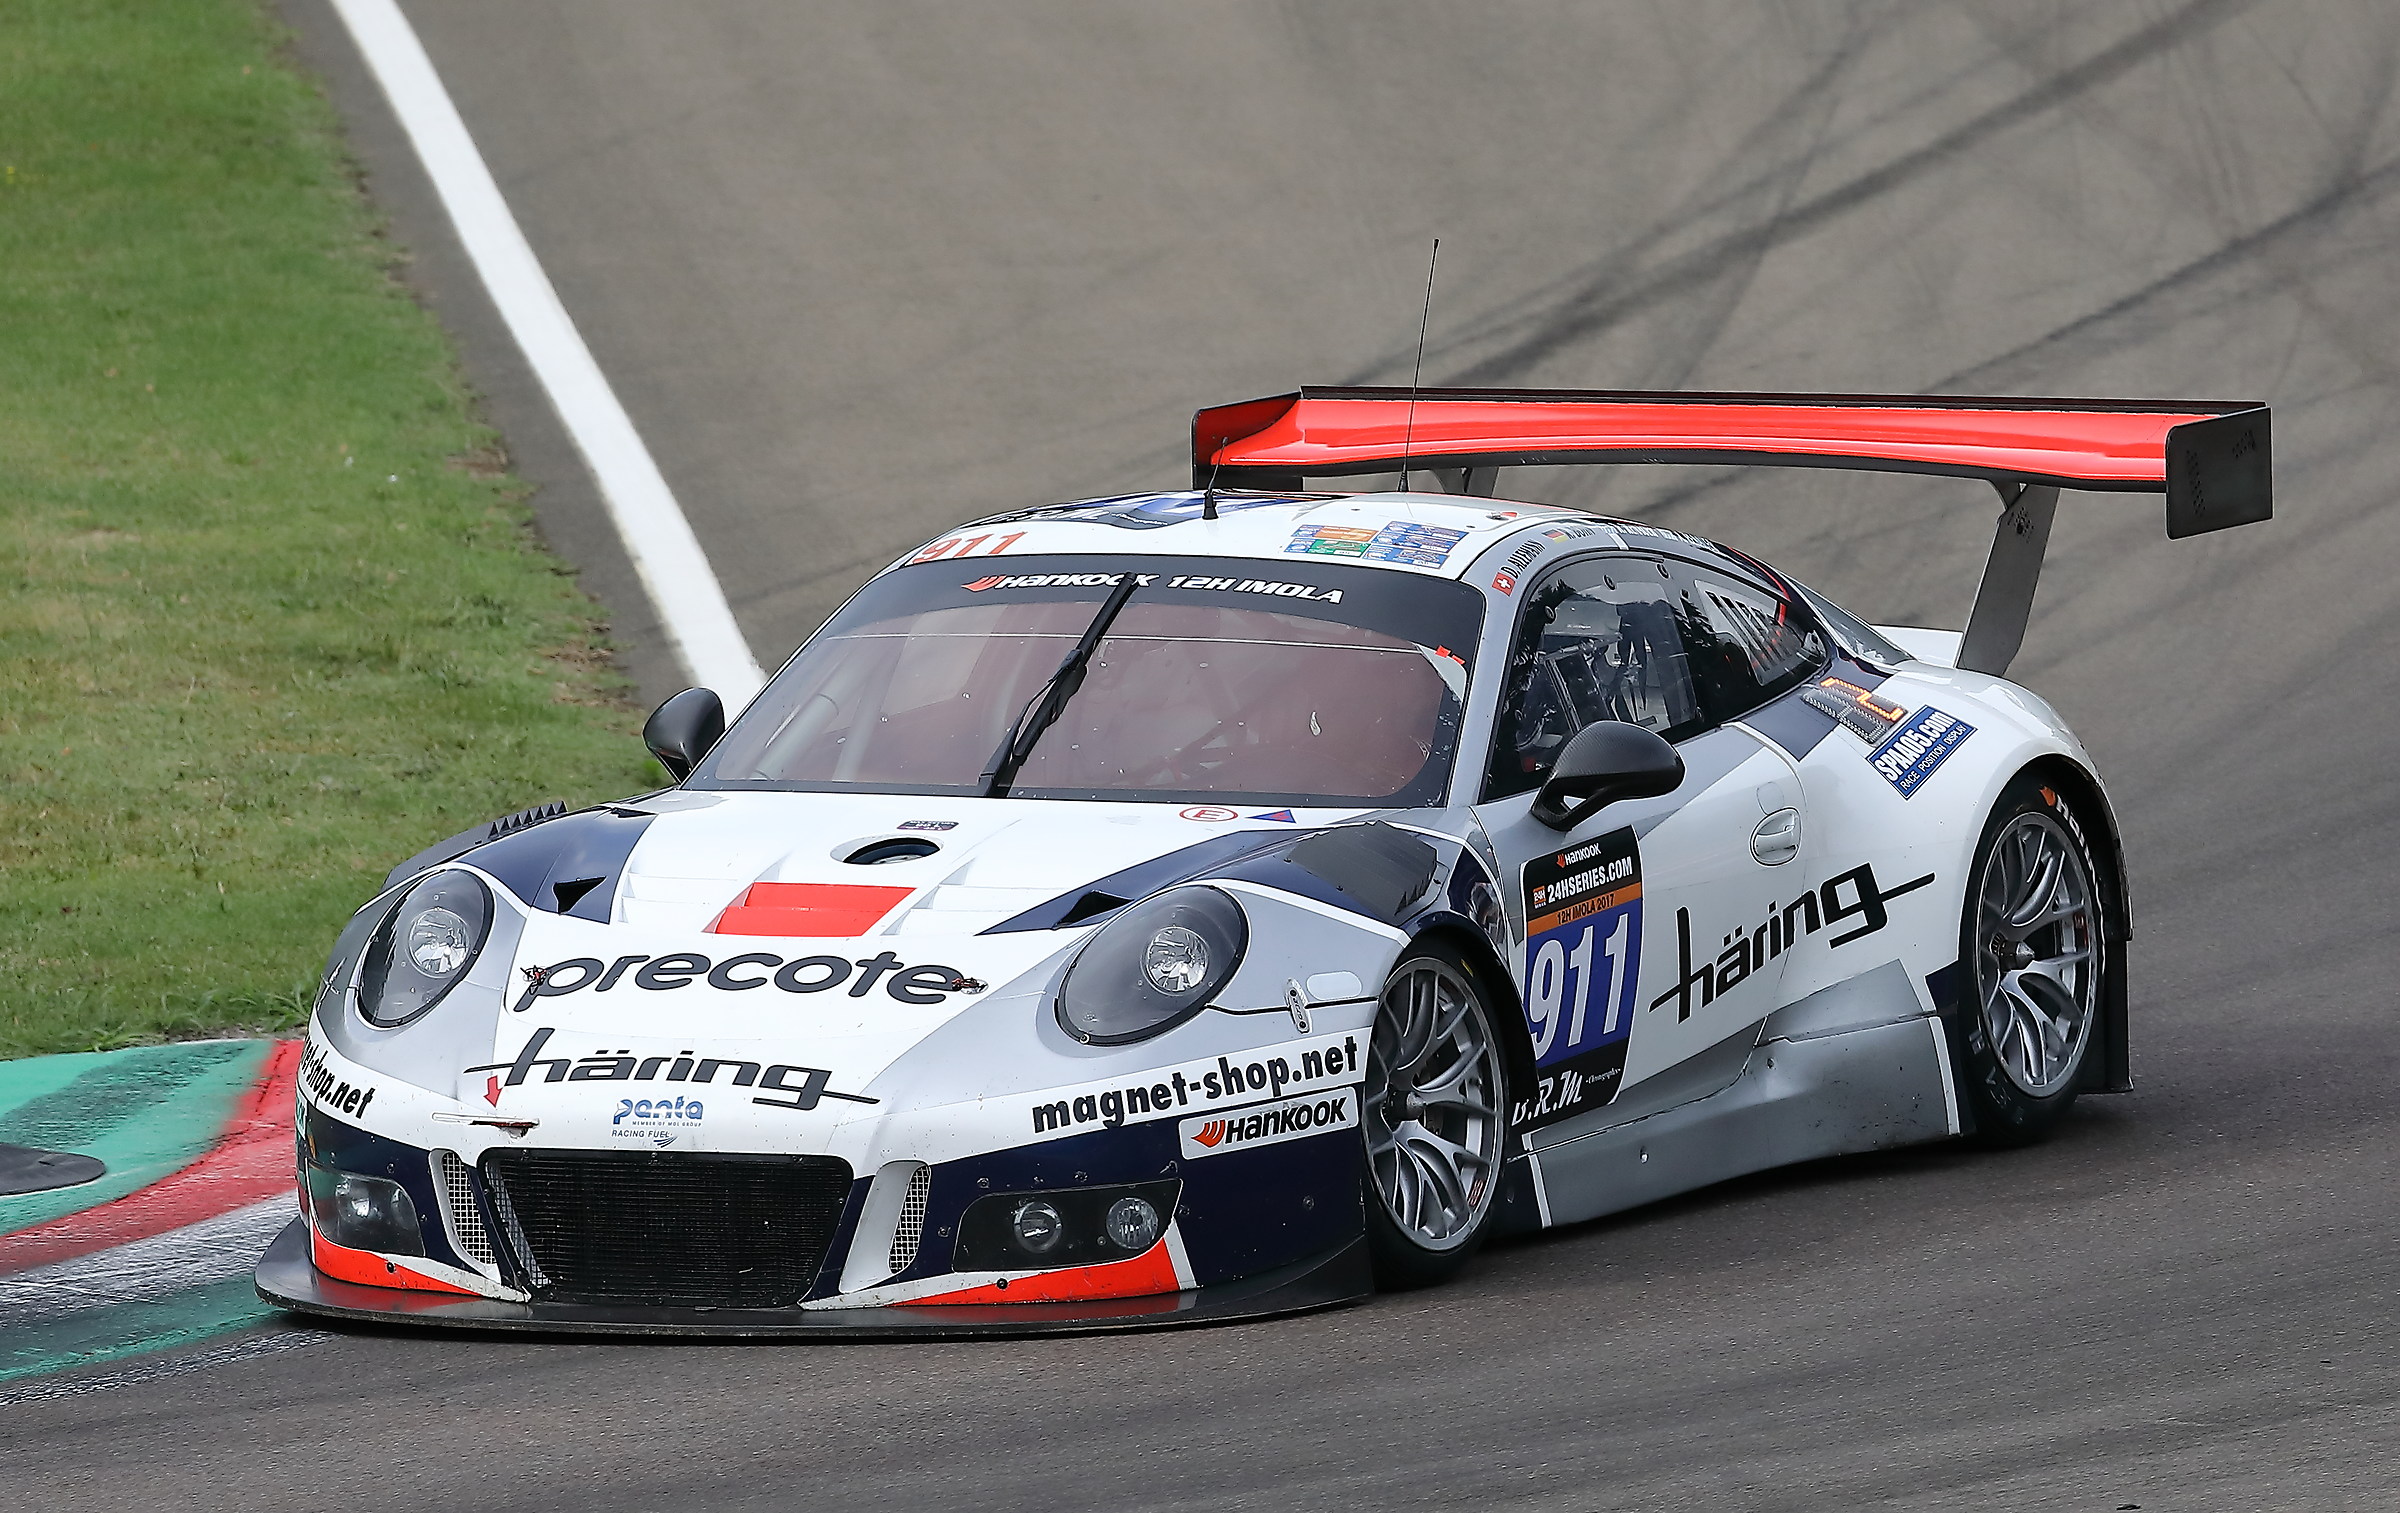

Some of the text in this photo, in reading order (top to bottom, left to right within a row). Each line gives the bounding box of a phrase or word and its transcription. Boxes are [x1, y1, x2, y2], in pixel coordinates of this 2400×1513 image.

[912, 531, 1028, 564] 911
[1167, 576, 1237, 591] 12H
[1233, 578, 1344, 604] IMOLA
[1899, 724, 1968, 791] RACE POSITION DISPLAY
[1547, 855, 1633, 904] 24HSERIES.COM
[1557, 893, 1616, 925] 12H IMOLA 2017
[513, 951, 965, 1012] precote
[1529, 912, 1629, 1061] 911
[463, 1028, 881, 1111] häring
[1032, 1036, 1359, 1129] magnet-shop.net
[613, 1095, 704, 1124] panta
[611, 1130, 670, 1139] RACING FUEL
